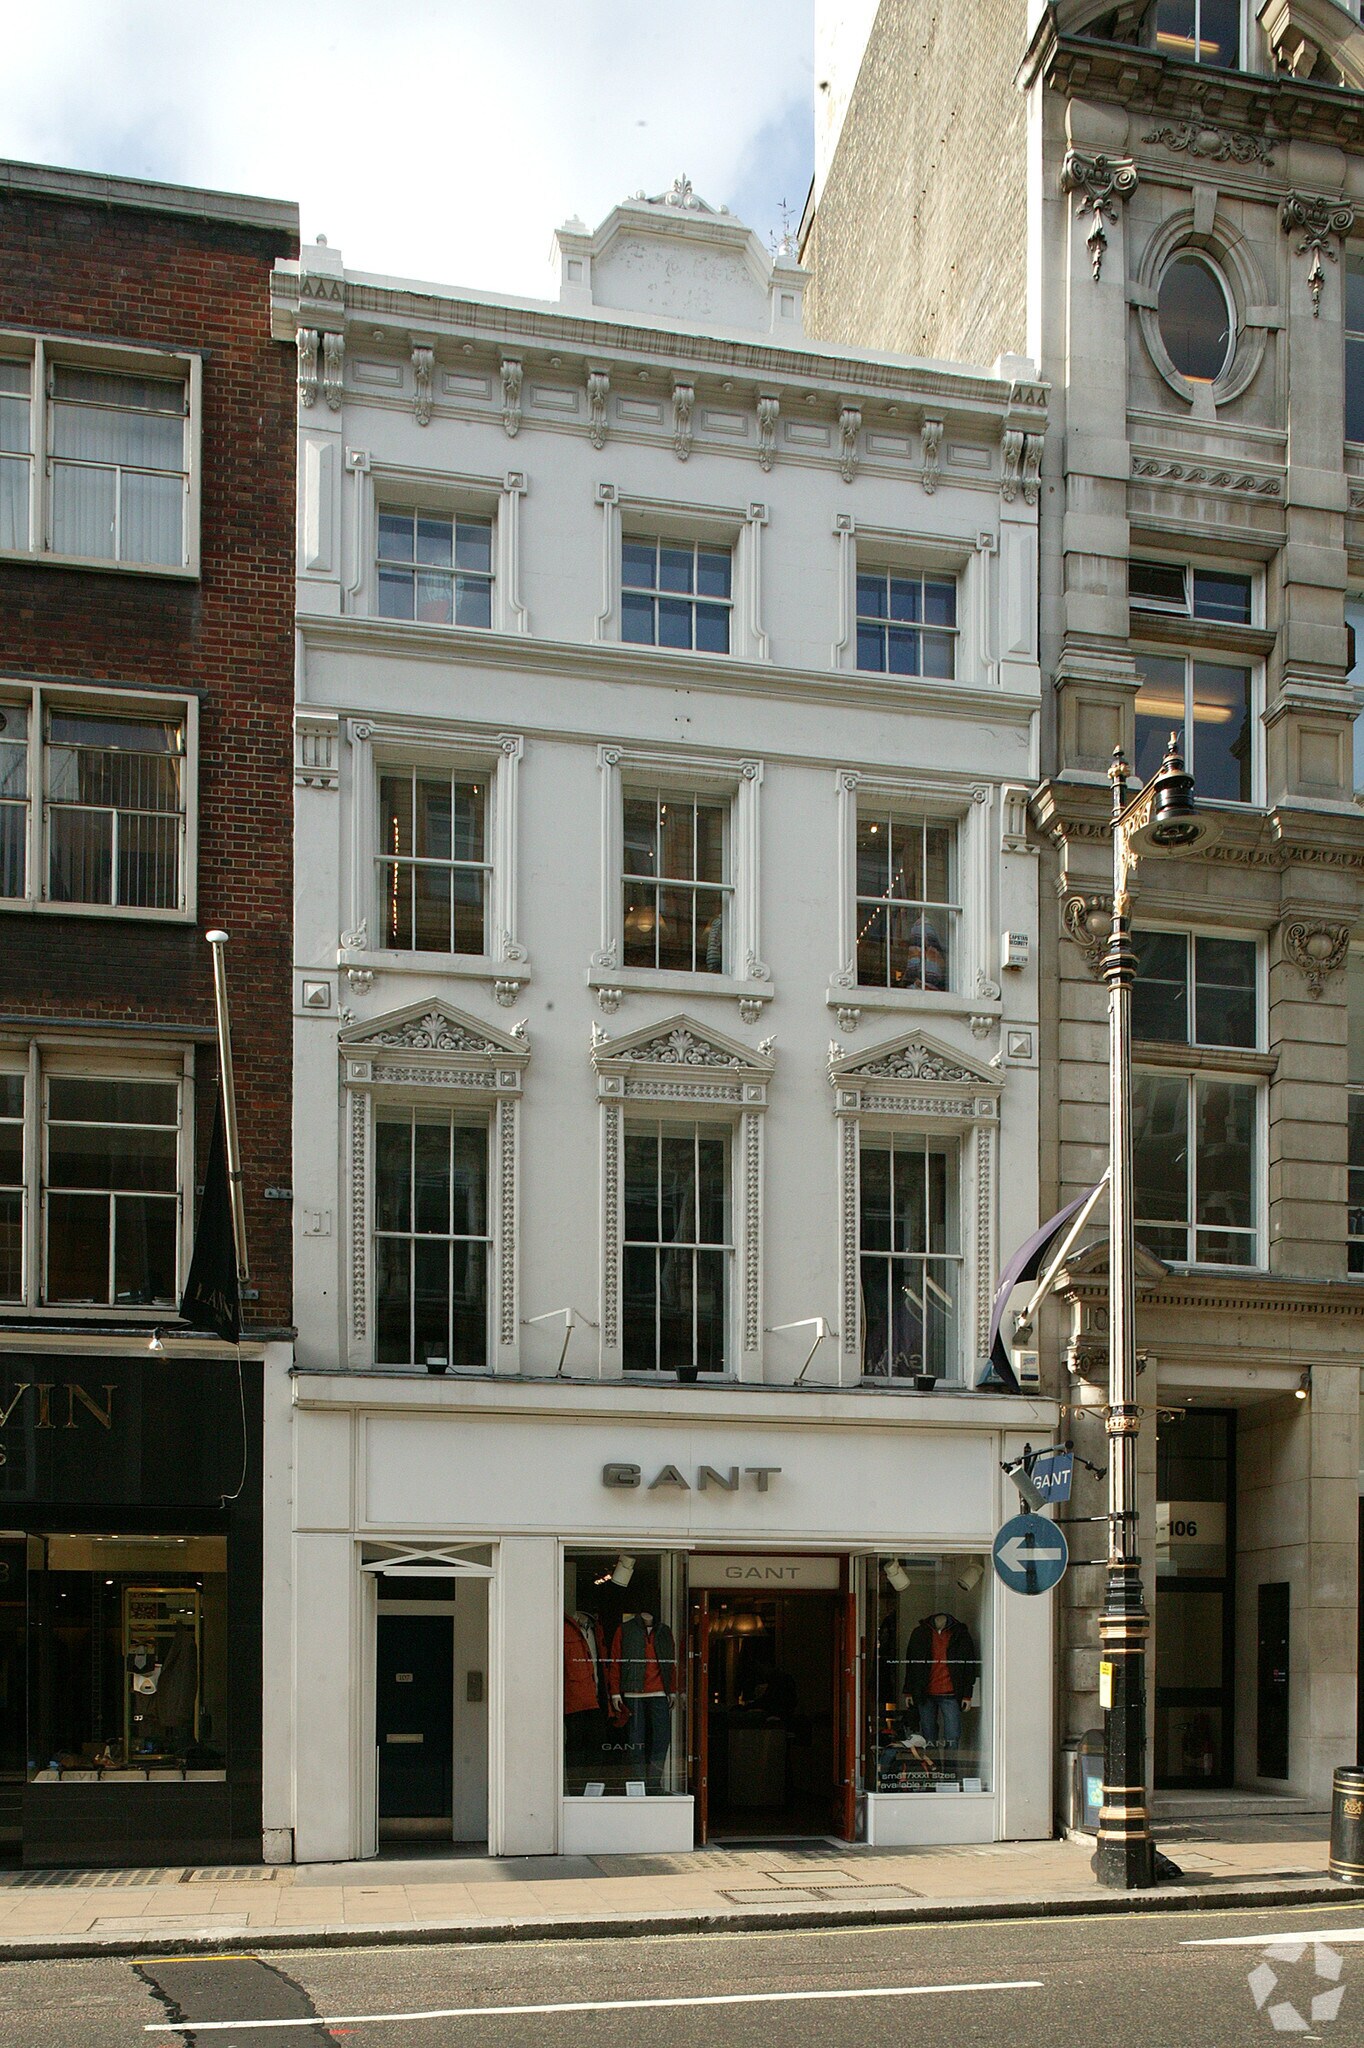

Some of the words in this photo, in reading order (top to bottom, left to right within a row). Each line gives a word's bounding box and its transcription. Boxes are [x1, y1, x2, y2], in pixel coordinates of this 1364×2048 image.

[602, 1463, 782, 1492] GANT
[1033, 1469, 1071, 1489] GANT
[725, 1566, 801, 1580] GANT
[601, 1743, 645, 1751] GANT
[926, 1739, 956, 1747] ANT
[931, 1771, 956, 1779] sizes
